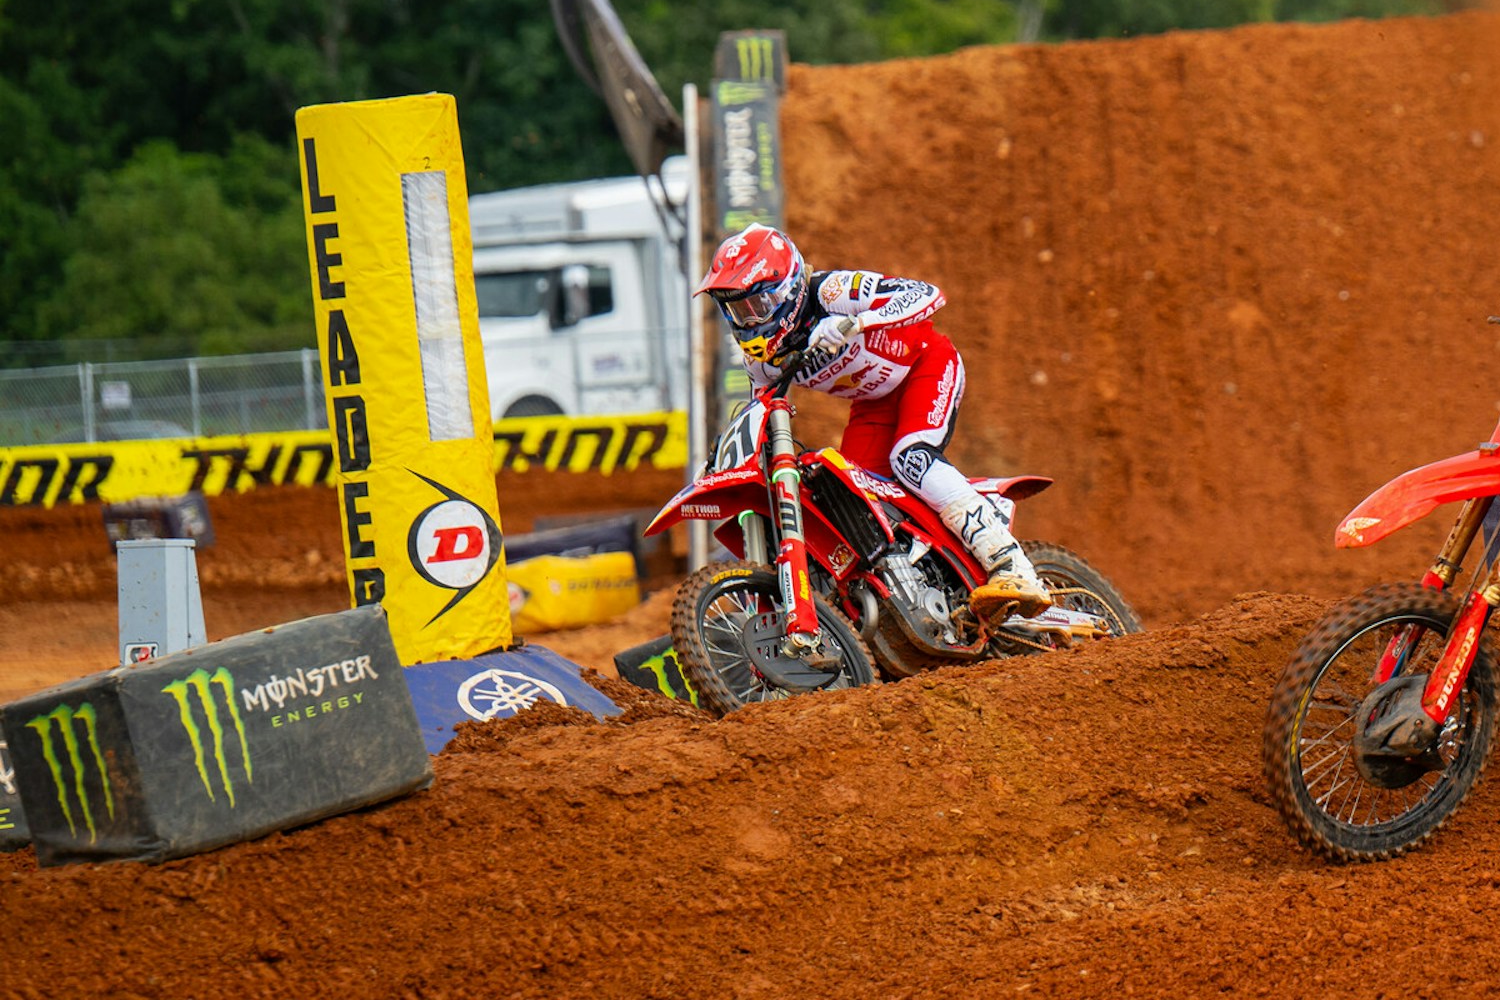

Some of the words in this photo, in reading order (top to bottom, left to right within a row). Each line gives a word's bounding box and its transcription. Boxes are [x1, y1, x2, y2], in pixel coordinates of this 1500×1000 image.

[863, 366, 893, 392] Bull
[494, 424, 668, 468] HOR
[0, 455, 114, 506] OR
[181, 446, 334, 492] THO
[681, 504, 720, 514] METHOD
[241, 655, 379, 713] MONSTER
[1436, 626, 1476, 711] DUNLOP
[272, 692, 365, 728] ENERGY
